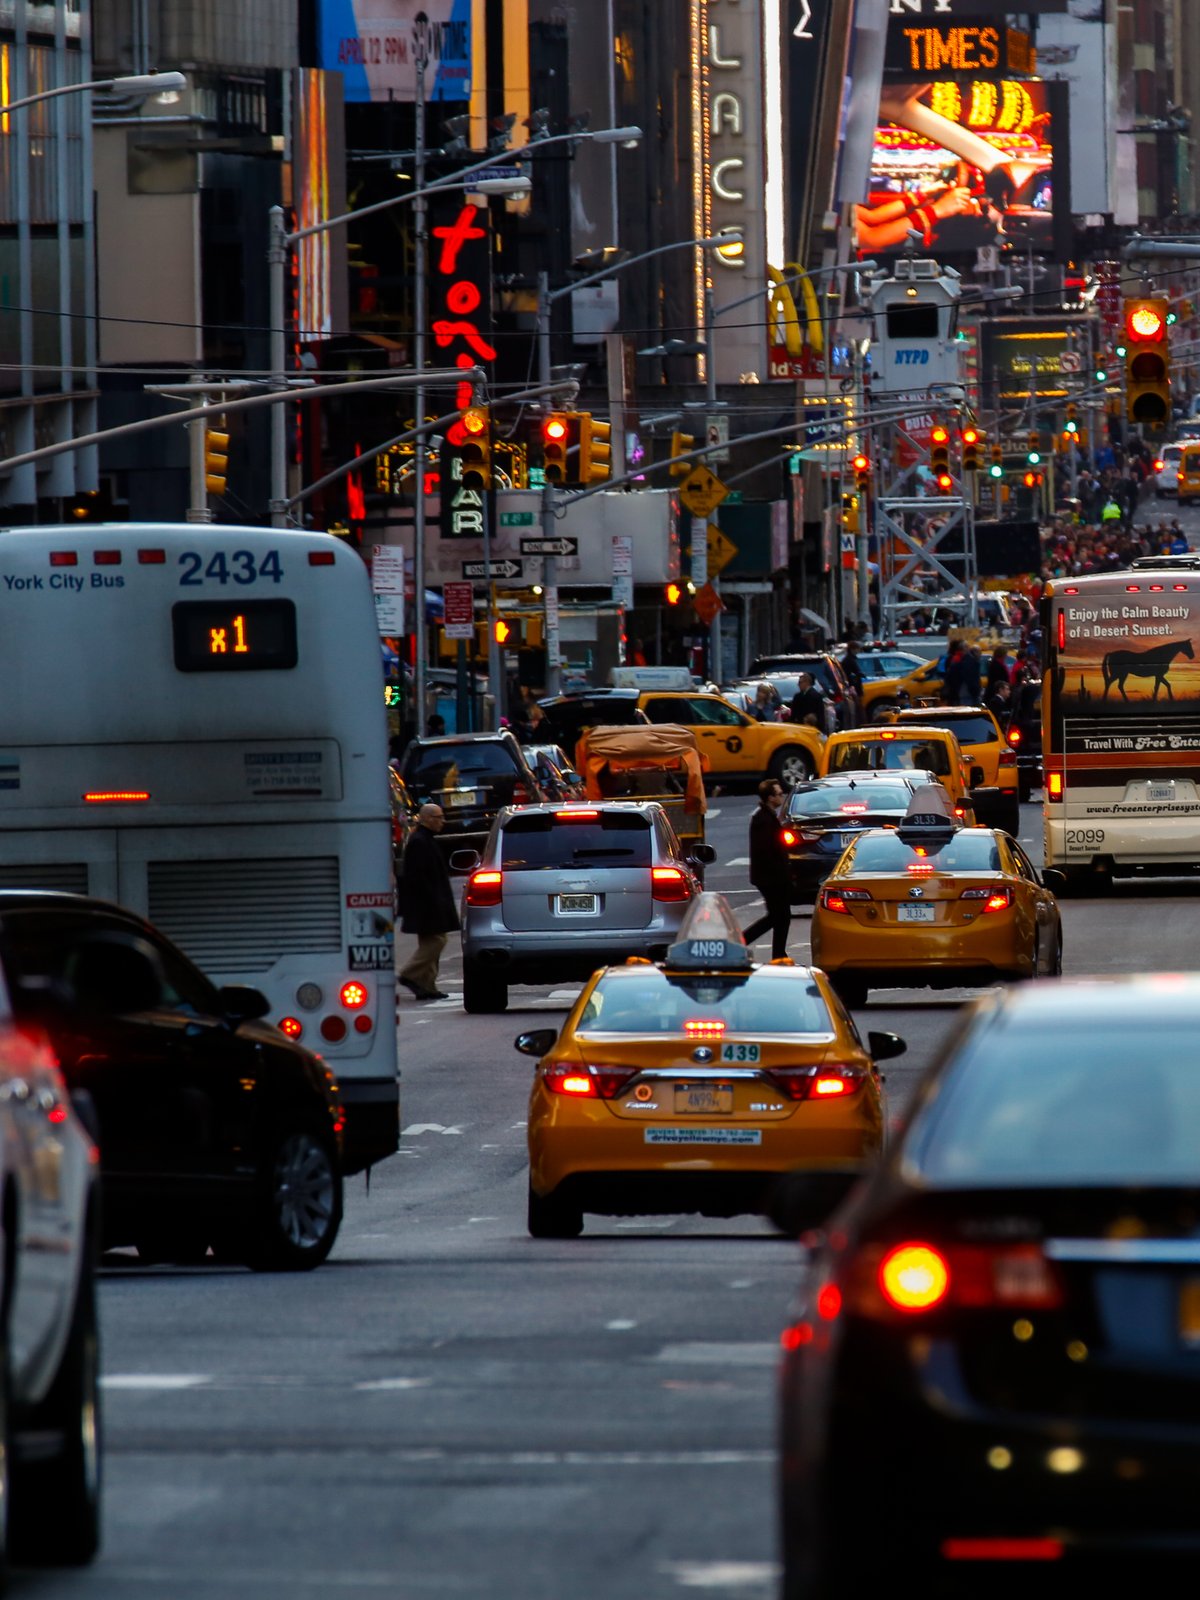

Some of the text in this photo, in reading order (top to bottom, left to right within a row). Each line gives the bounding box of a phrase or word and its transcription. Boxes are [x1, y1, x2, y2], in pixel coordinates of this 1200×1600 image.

[338, 37, 408, 64] APRIL 12 9PM
[902, 27, 999, 71] TIMES
[894, 349, 930, 365] NYPD
[551, 543, 569, 551] WAY
[178, 549, 285, 587] 2434
[495, 564, 514, 574] WAY
[3, 573, 125, 592] York City Bus
[1069, 605, 1190, 622] Enjoy the Calm Beauty
[1069, 623, 1173, 638] of a Desert Sunset.
[1083, 738, 1112, 750] Travel
[1114, 737, 1134, 749] With
[1135, 736, 1166, 750] Free
[913, 814, 936, 825] 3L33
[1066, 829, 1105, 844] 2099
[350, 895, 394, 906] CAUTIO
[352, 946, 393, 962] WID
[690, 941, 725, 958] 4N99
[723, 1044, 760, 1062] 439
